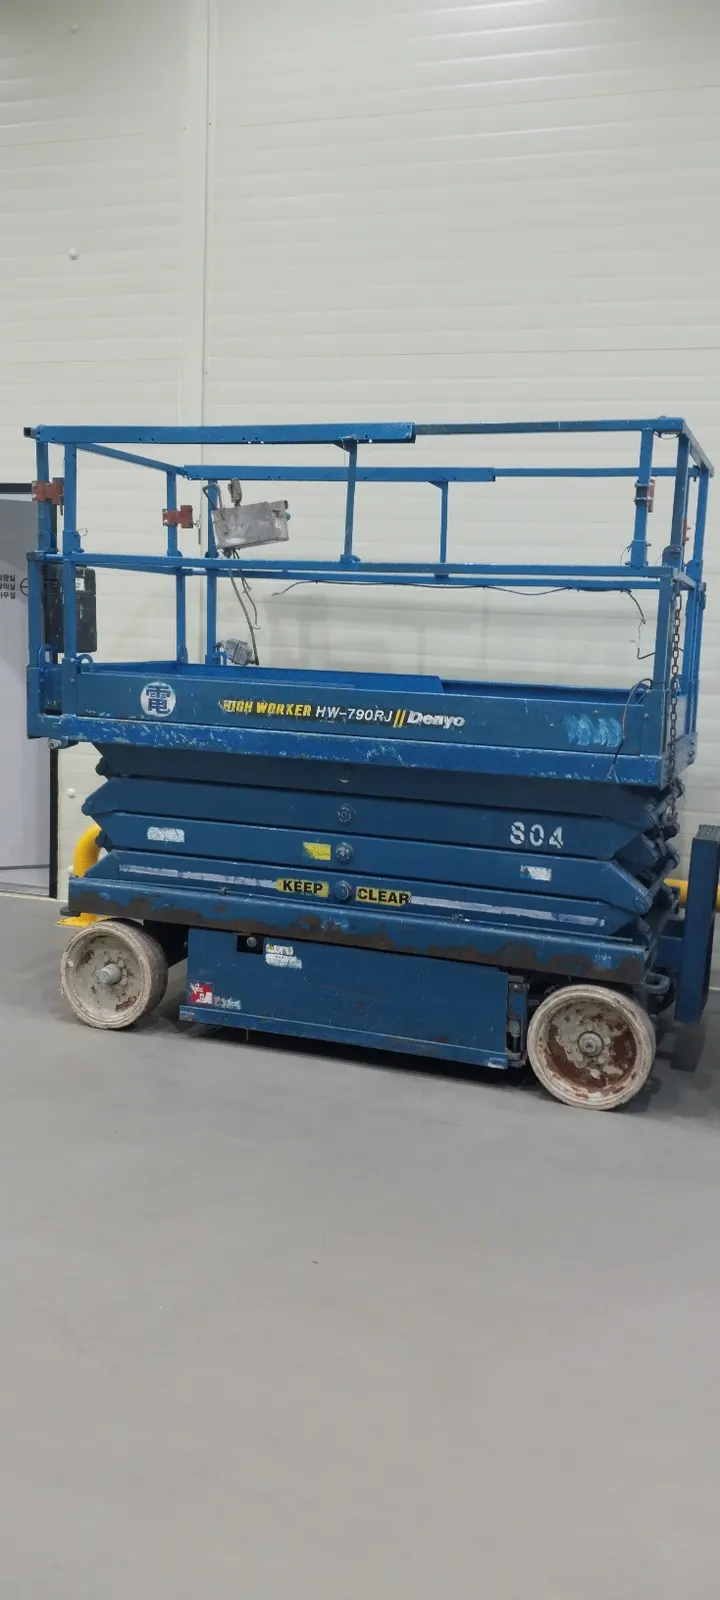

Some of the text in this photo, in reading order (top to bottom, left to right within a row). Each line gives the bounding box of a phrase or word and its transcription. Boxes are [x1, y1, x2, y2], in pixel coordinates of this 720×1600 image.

[146, 684, 171, 715] 電
[256, 701, 312, 717] WORKER
[315, 705, 393, 723] HW-790RJ
[407, 710, 465, 729] Denyo
[509, 821, 564, 849] 804
[282, 879, 412, 905] KEEP CLEAR
